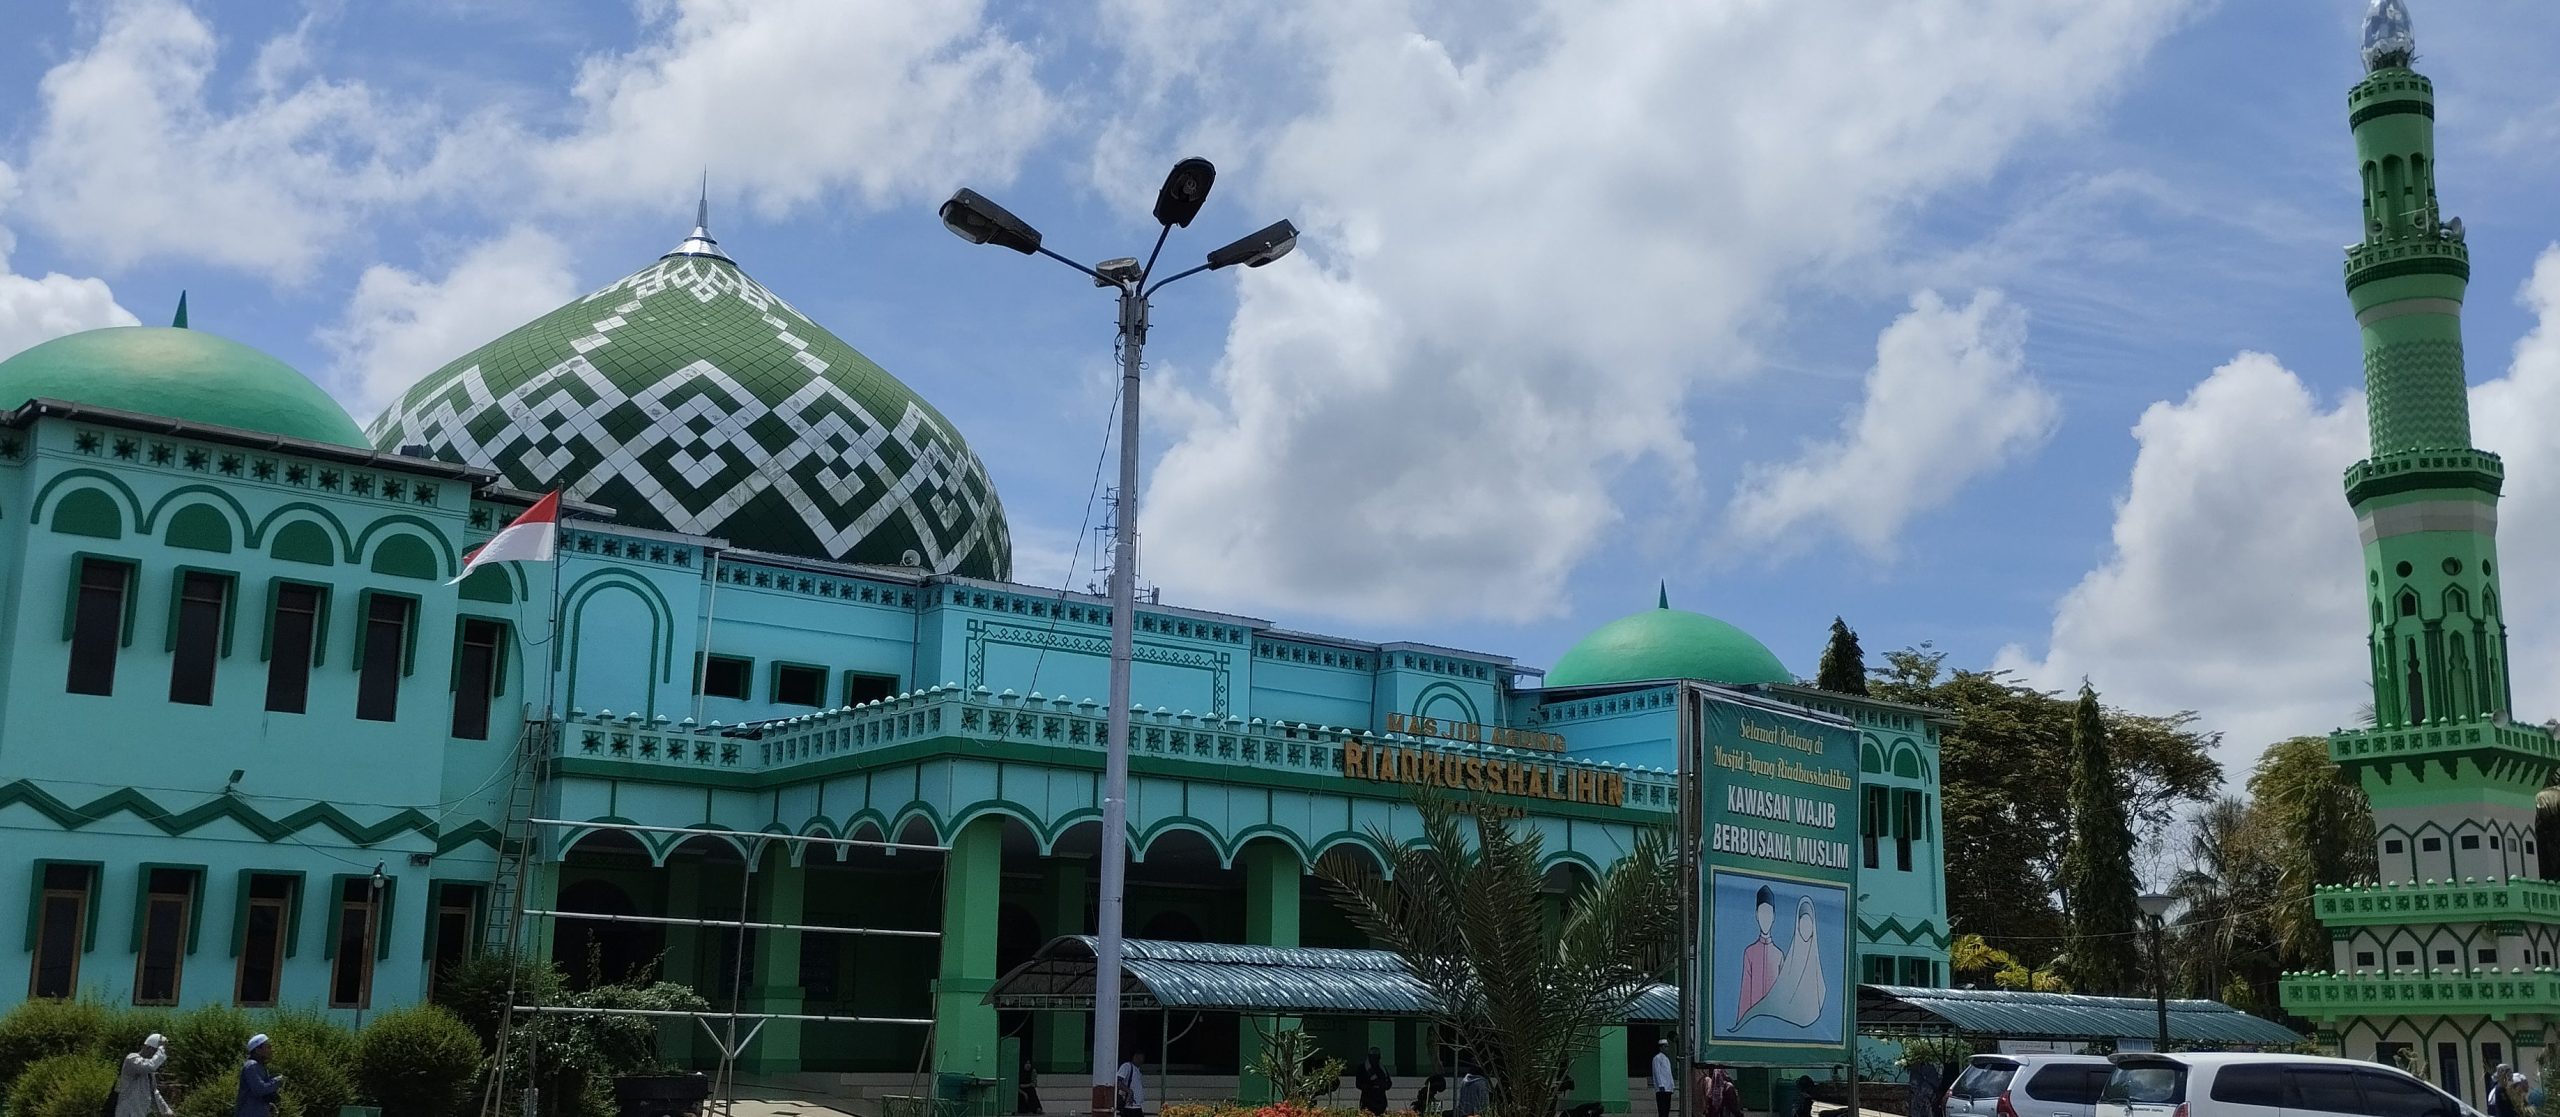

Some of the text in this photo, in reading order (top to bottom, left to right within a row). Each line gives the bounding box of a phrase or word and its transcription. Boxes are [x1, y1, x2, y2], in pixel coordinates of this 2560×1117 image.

[1387, 712, 1567, 753] MASJID AGUNG
[1740, 717, 1823, 755] Selamat Datang di
[1343, 742, 1626, 807] RIADHUSSHALIHIN
[1714, 745, 1851, 790] Masjid Agung Riadhusshalihin
[1727, 784, 1836, 829] KAWASAN WAJIB
[1712, 823, 1849, 869] BERBUSANA MUSLIM
